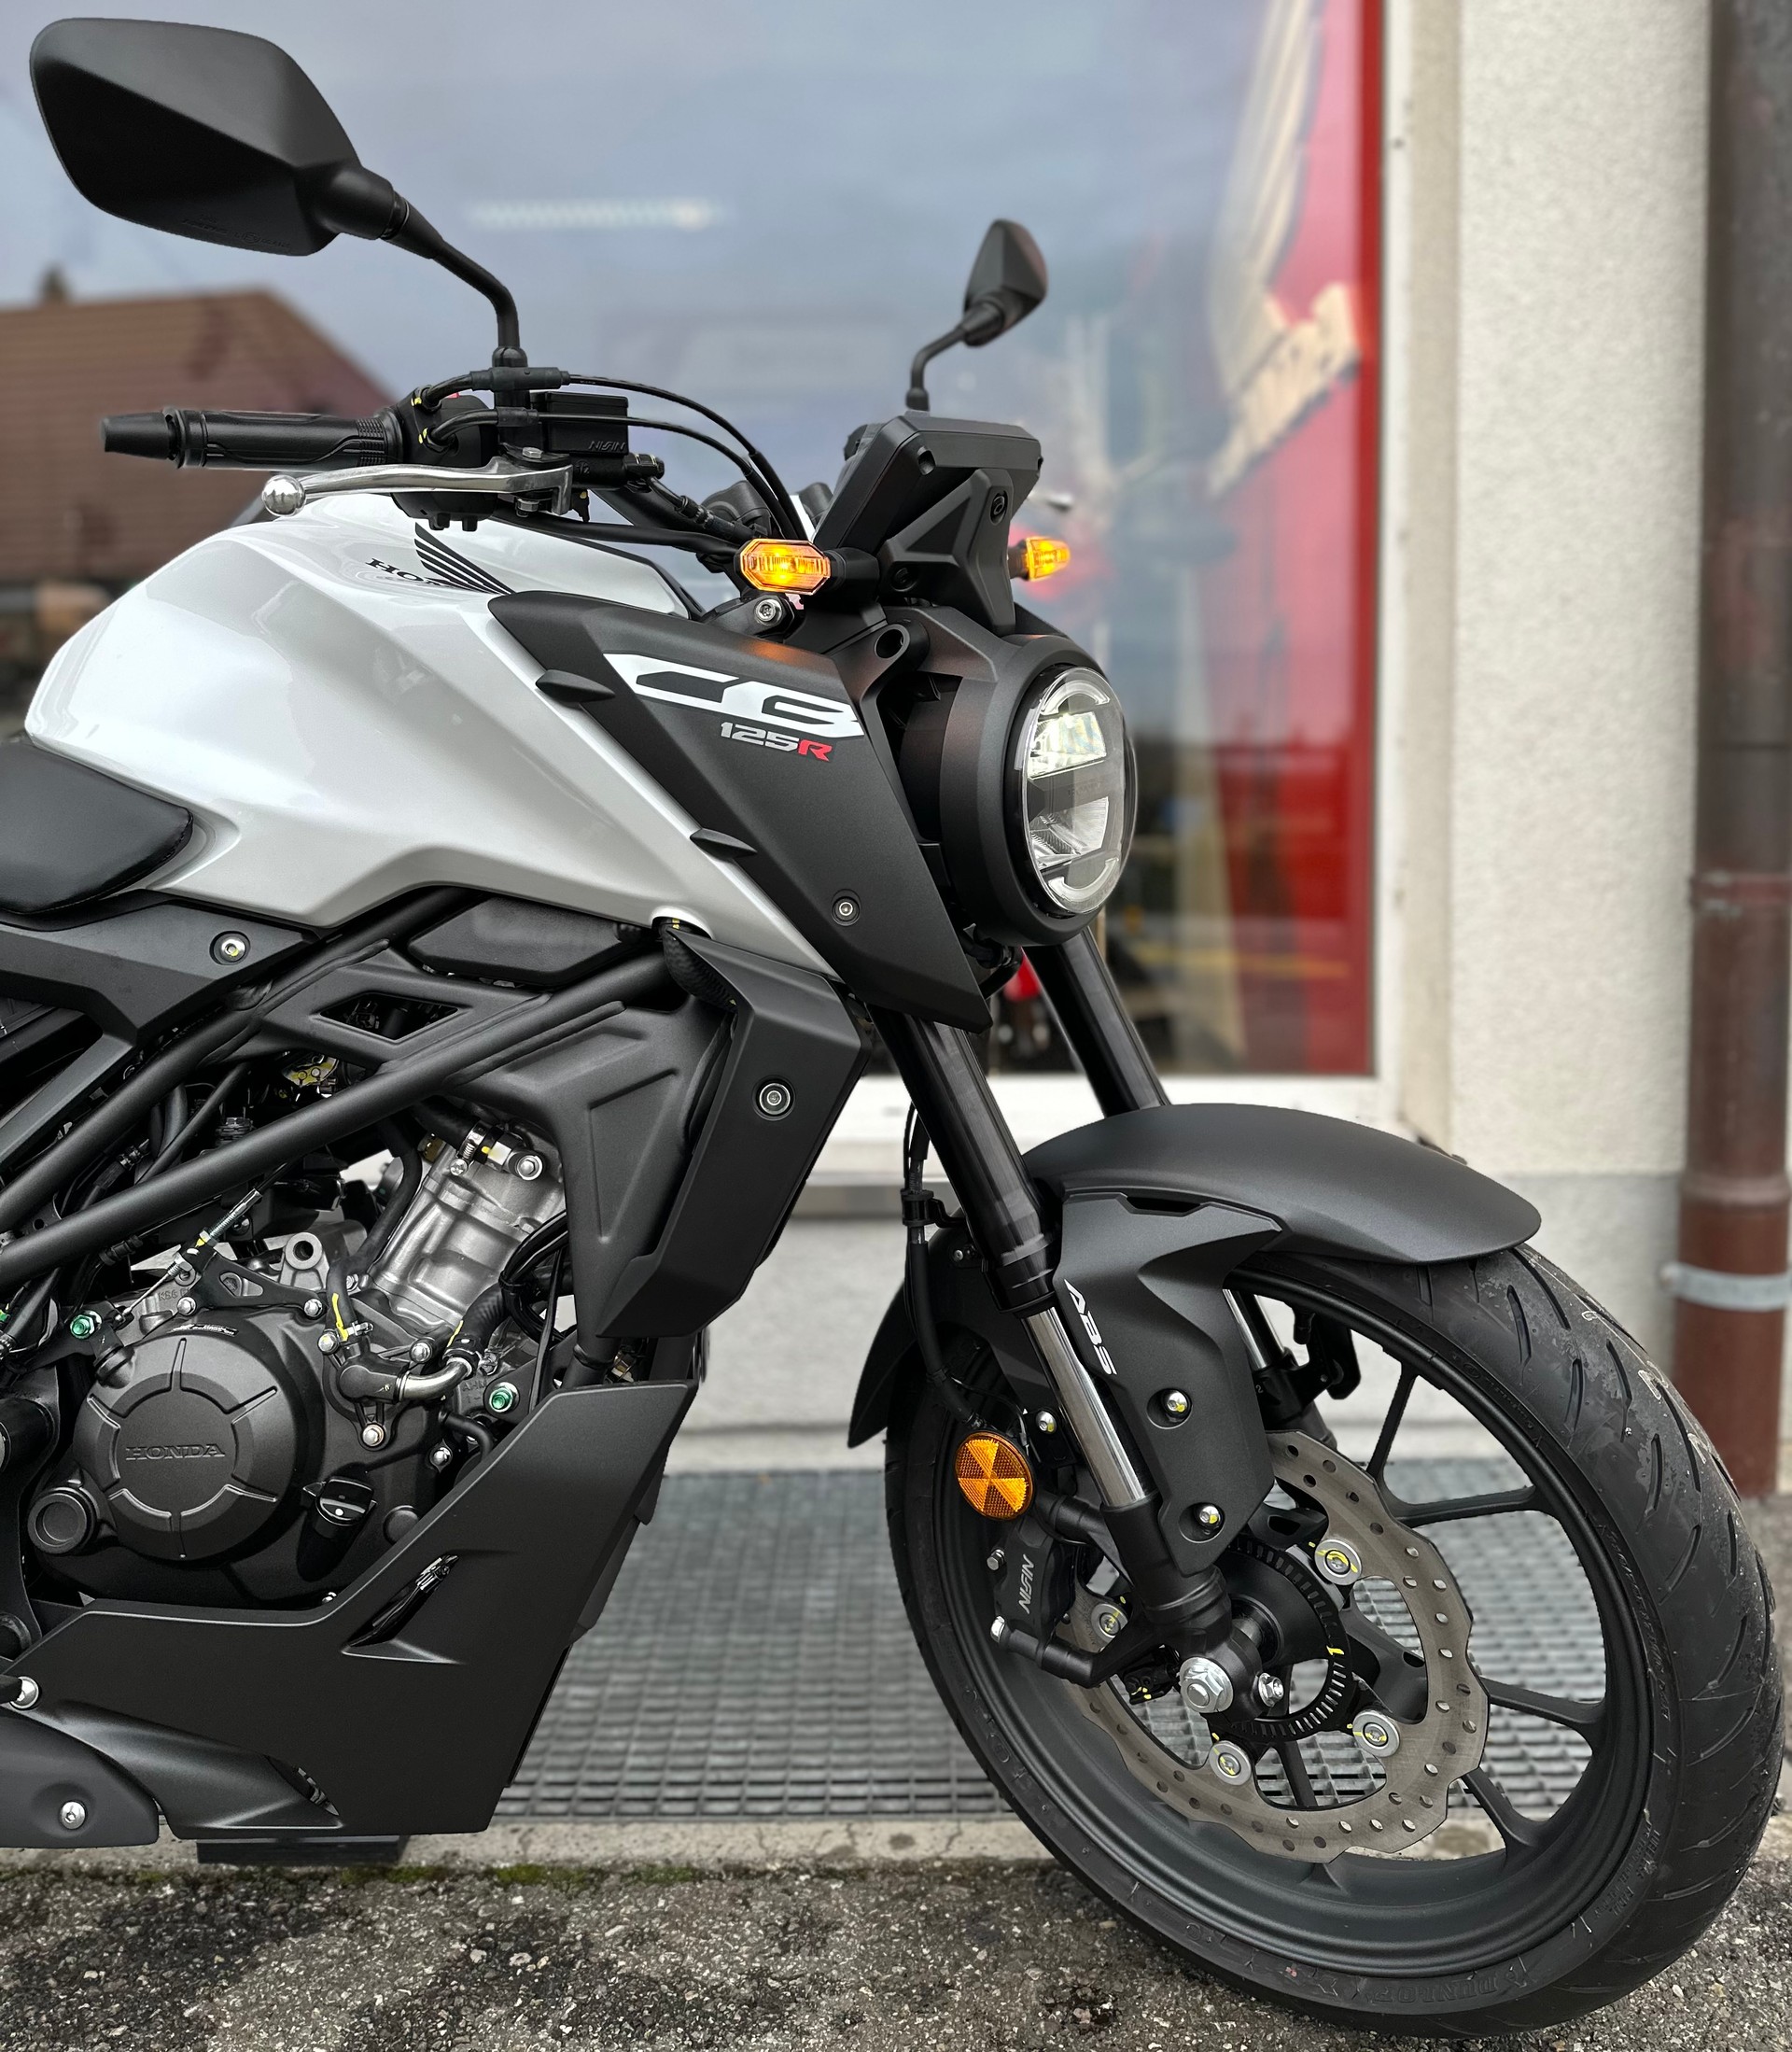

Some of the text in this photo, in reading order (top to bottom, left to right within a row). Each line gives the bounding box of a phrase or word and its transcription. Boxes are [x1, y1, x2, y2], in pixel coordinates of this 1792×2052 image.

[603, 654, 865, 738] CB
[721, 722, 833, 762] 125R
[1064, 1279, 1117, 1374] ABS
[125, 1443, 225, 1460] HONDA
[1373, 1973, 1498, 2003] DUNLOP
